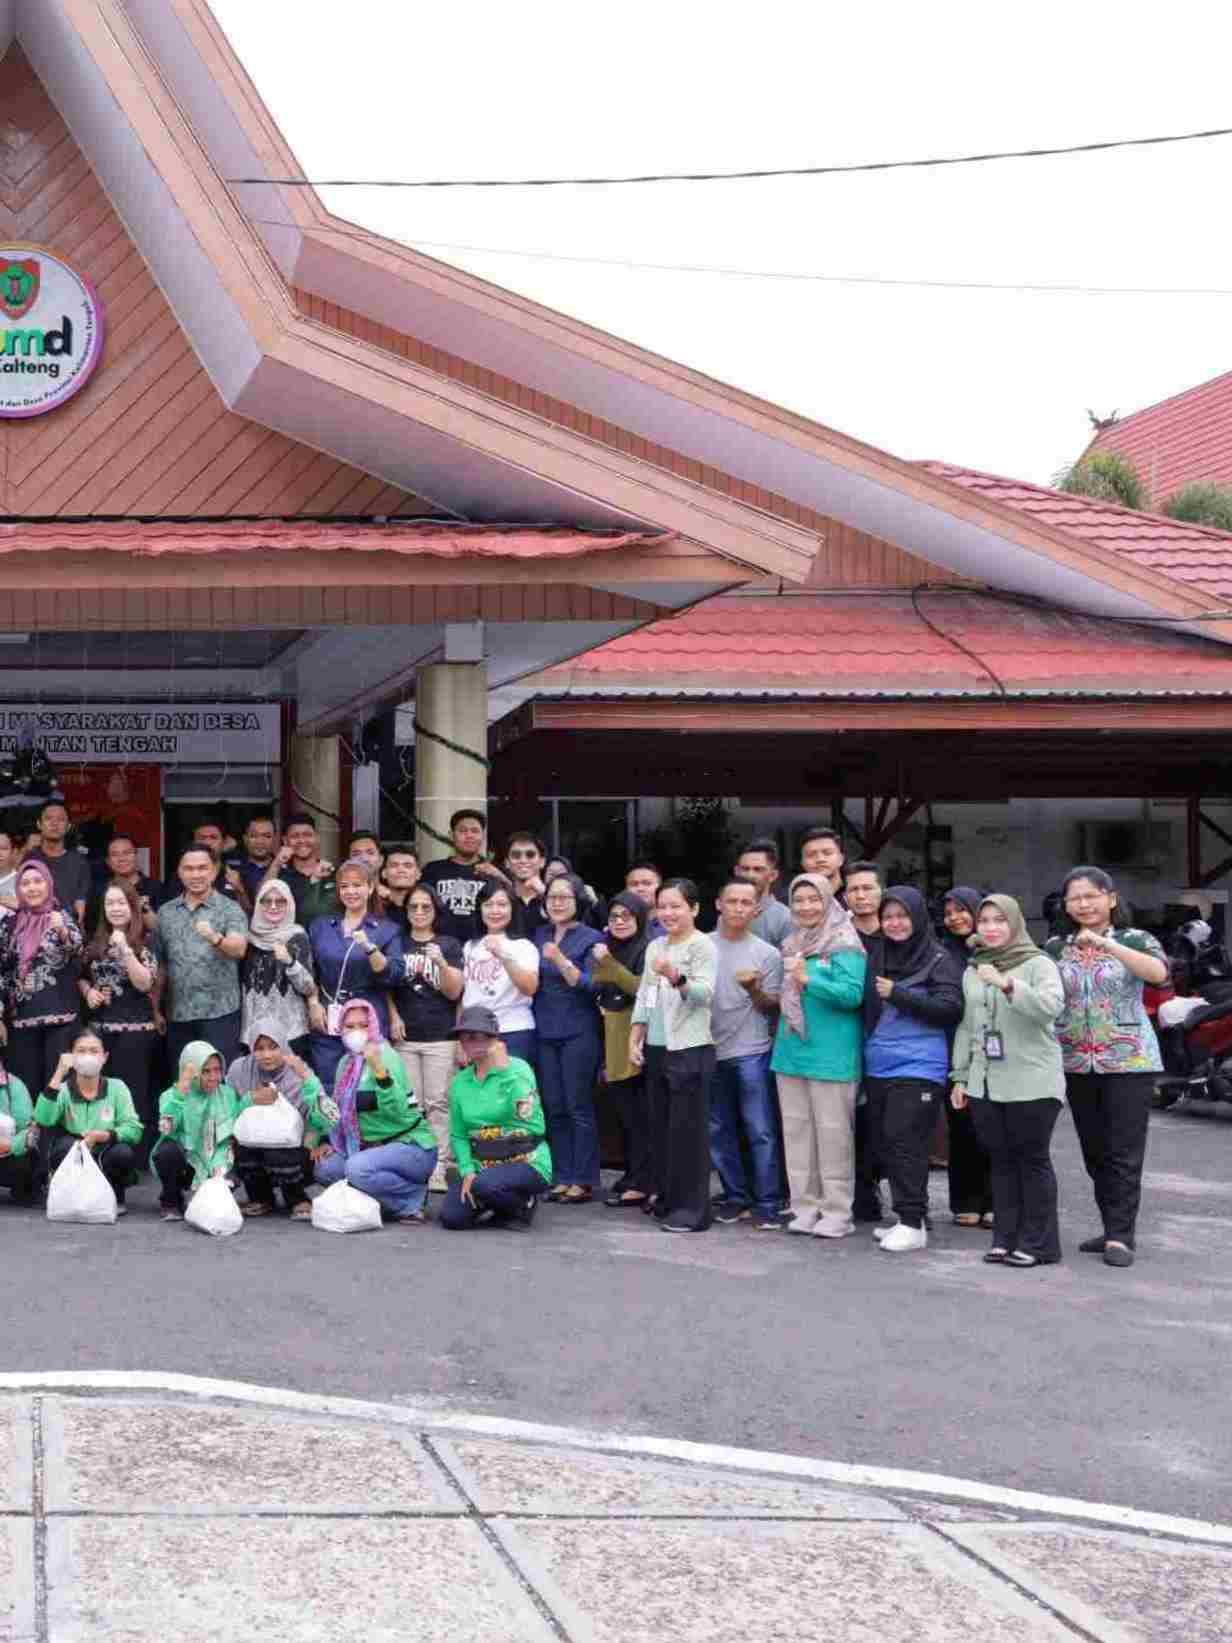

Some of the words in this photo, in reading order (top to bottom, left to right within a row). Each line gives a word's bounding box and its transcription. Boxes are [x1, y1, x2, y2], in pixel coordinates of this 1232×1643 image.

[154, 711, 198, 730] DAN
[203, 711, 261, 730] DESA
[93, 735, 177, 753] TENGAH
